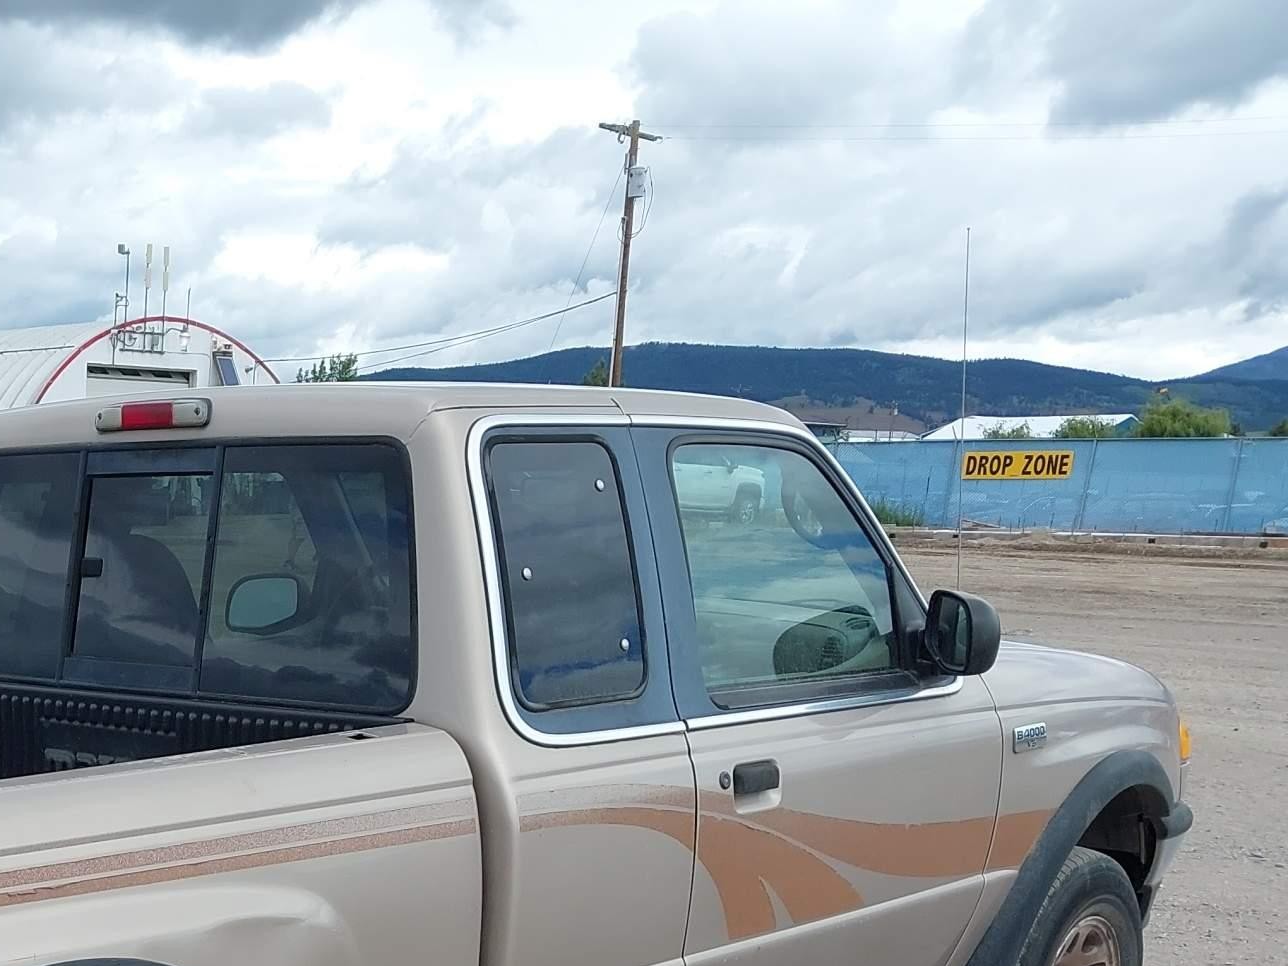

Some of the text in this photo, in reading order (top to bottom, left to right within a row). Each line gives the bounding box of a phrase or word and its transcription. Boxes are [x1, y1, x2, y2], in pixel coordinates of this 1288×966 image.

[965, 454, 1070, 476] DROP ZONE
[1017, 725, 1046, 740] B4000
